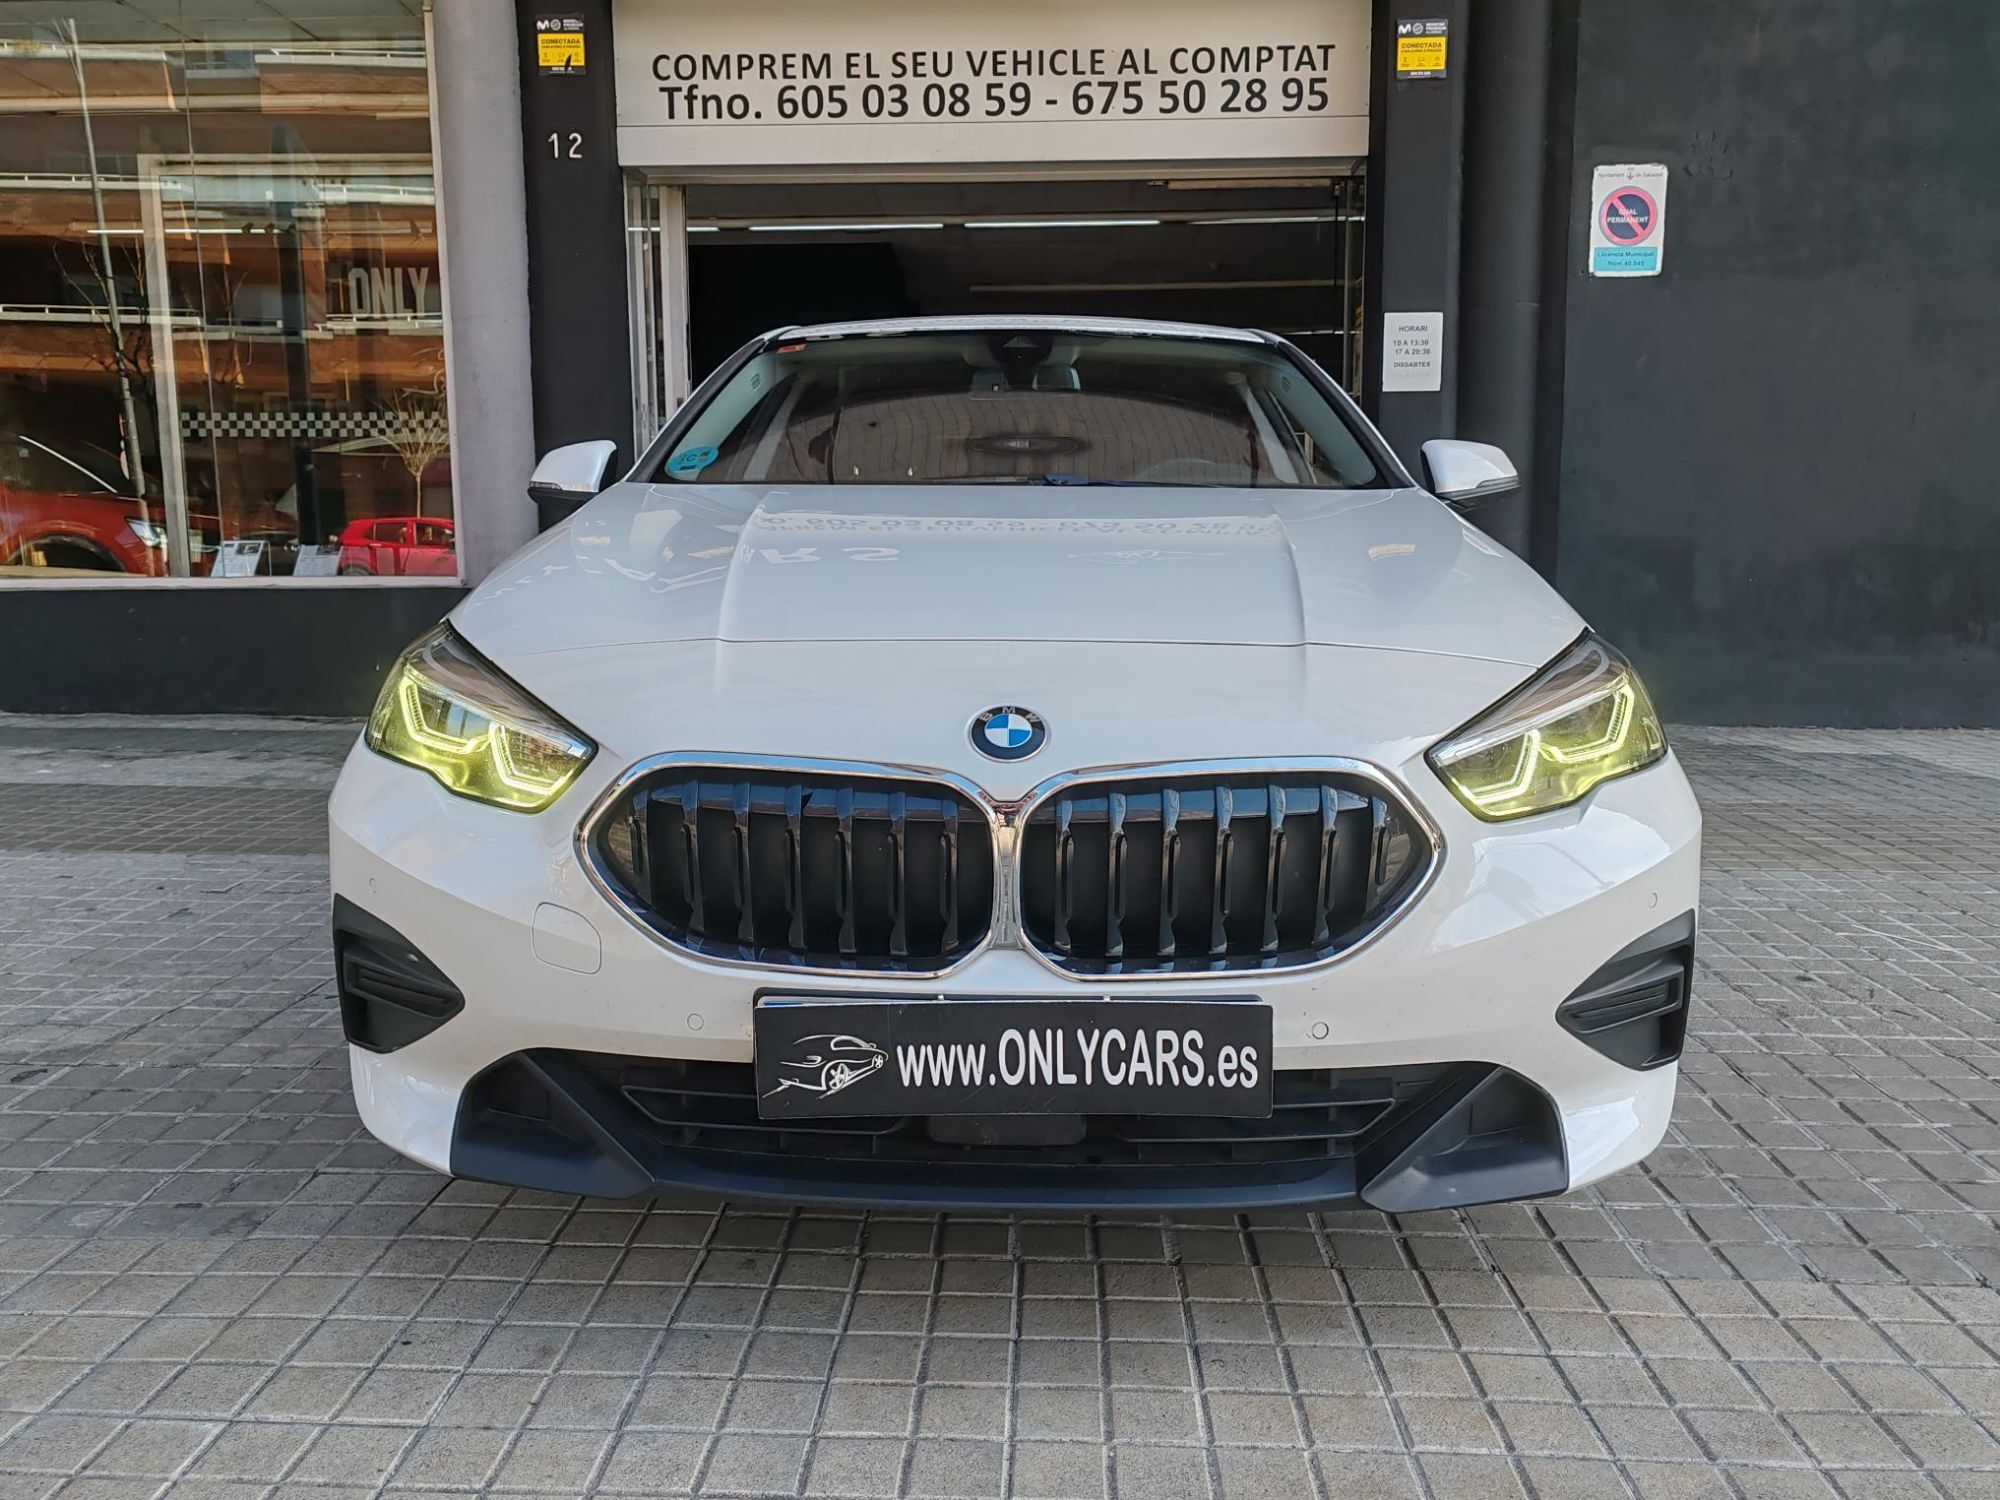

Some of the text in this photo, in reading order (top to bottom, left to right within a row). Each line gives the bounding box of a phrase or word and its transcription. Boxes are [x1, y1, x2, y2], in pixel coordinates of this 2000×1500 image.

[652, 44, 1336, 82] COMPREM EL SEU VEHICLE AL COMPTAT
[658, 84, 762, 120] Tfno.
[777, 84, 848, 119] 605
[862, 83, 909, 118] 03
[923, 82, 970, 117] 08
[985, 81, 1031, 117] 59
[1072, 80, 1144, 115] 675
[1159, 79, 1206, 114] 50
[1220, 78, 1267, 113] 28
[1281, 77, 1329, 112] 95
[548, 132, 583, 159] 12
[1606, 215, 1649, 224] PERMANENT
[348, 267, 429, 319] ONLY
[979, 705, 1041, 723] BMW
[896, 1027, 1259, 1089] www.ONLYCARS.es
